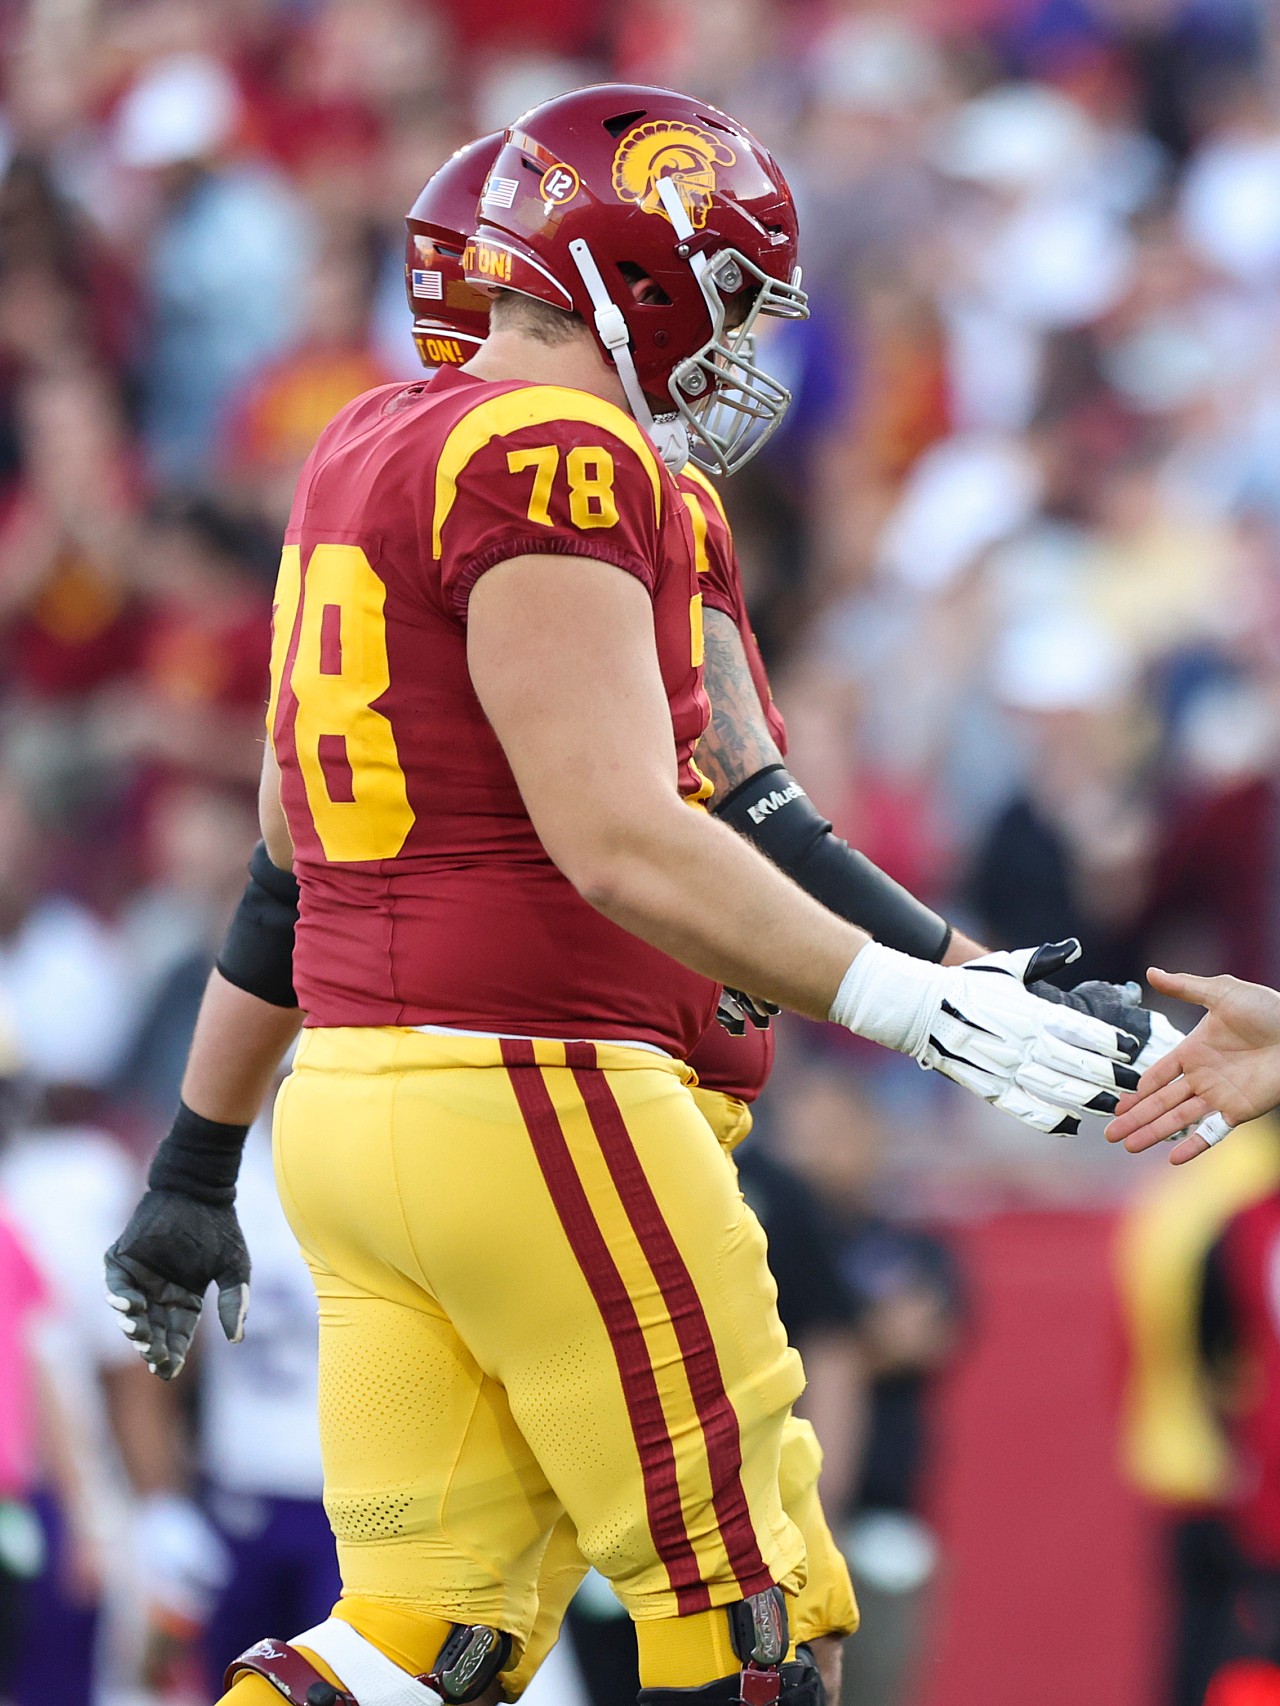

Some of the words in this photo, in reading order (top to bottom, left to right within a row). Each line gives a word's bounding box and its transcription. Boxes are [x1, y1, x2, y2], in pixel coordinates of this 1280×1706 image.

[545, 169, 573, 199] 12
[479, 248, 512, 282] ON!
[426, 339, 464, 363] ON!
[506, 445, 619, 529] 78
[267, 543, 416, 862] 78
